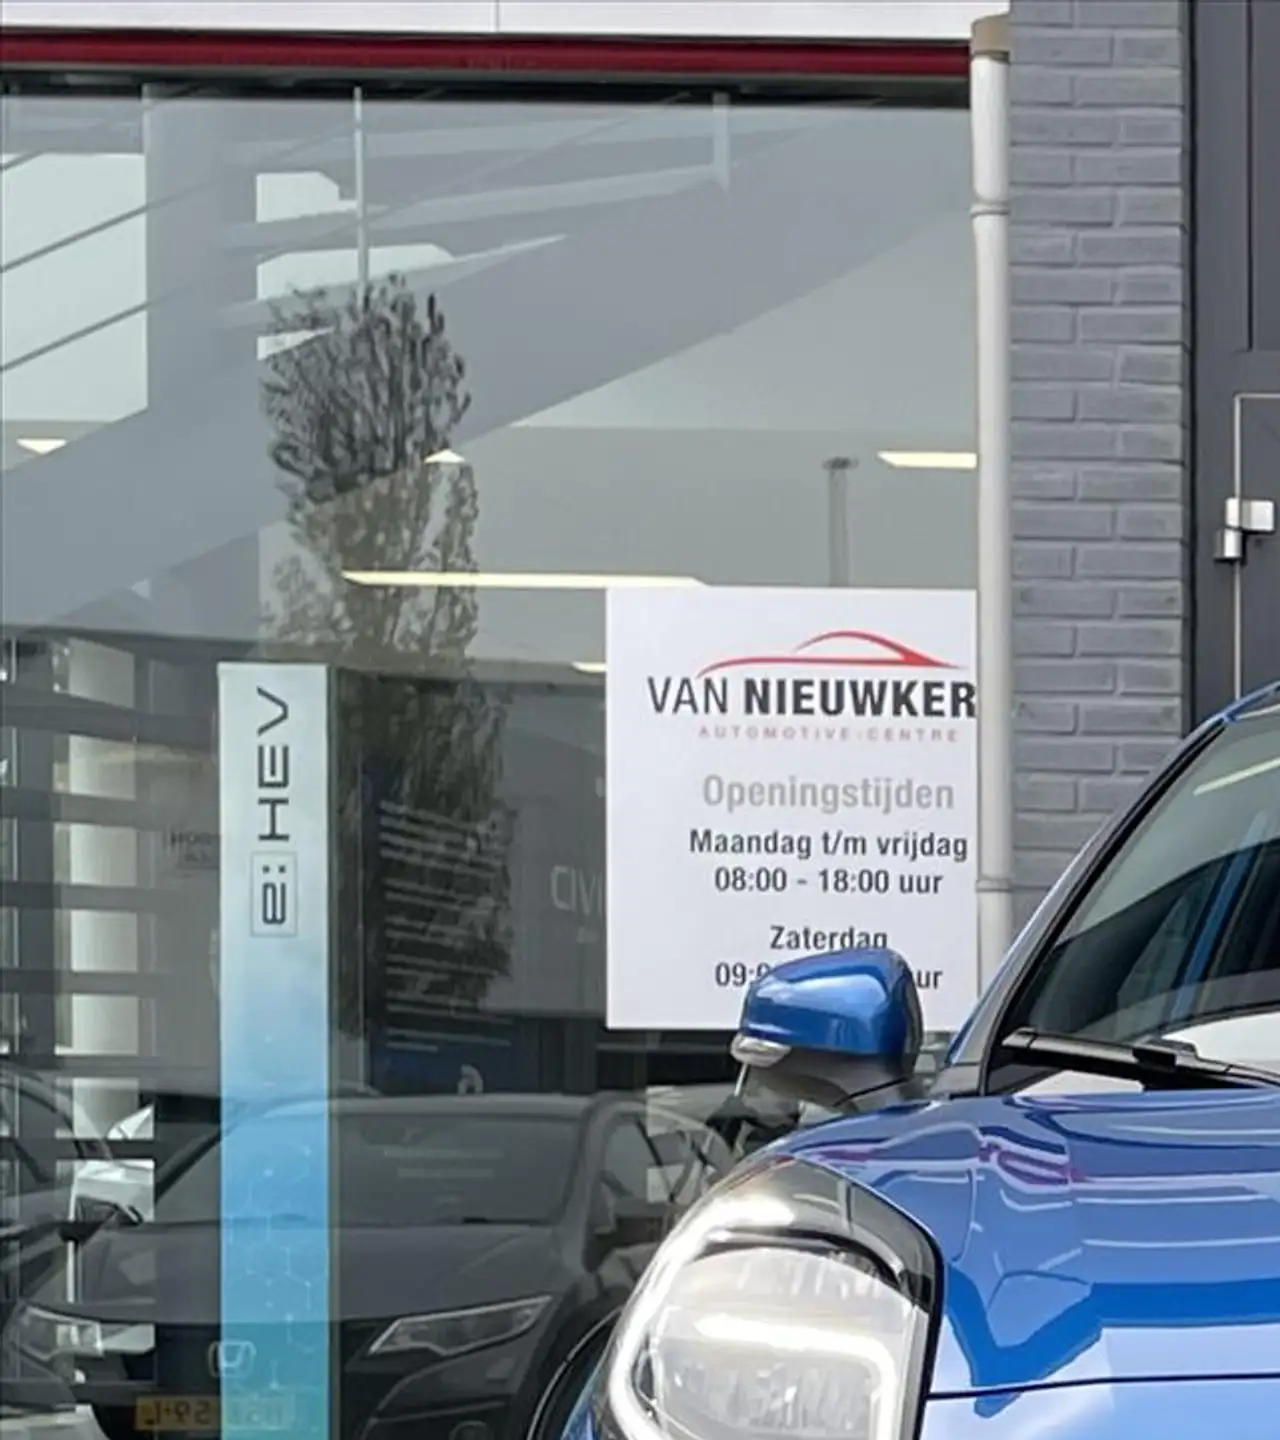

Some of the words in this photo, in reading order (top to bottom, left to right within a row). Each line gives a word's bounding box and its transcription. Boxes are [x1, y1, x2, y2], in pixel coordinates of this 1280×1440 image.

[647, 676, 728, 714] VAN
[743, 676, 977, 719] NIEUWKER
[703, 774, 955, 815] Openingstijden
[689, 828, 812, 860] Maandag
[822, 829, 867, 856] t/m
[876, 830, 969, 863] vrijdag
[714, 866, 788, 892] 08:00
[819, 868, 890, 894] 18:00
[898, 873, 944, 895] uur
[769, 924, 888, 951] Zaterdag
